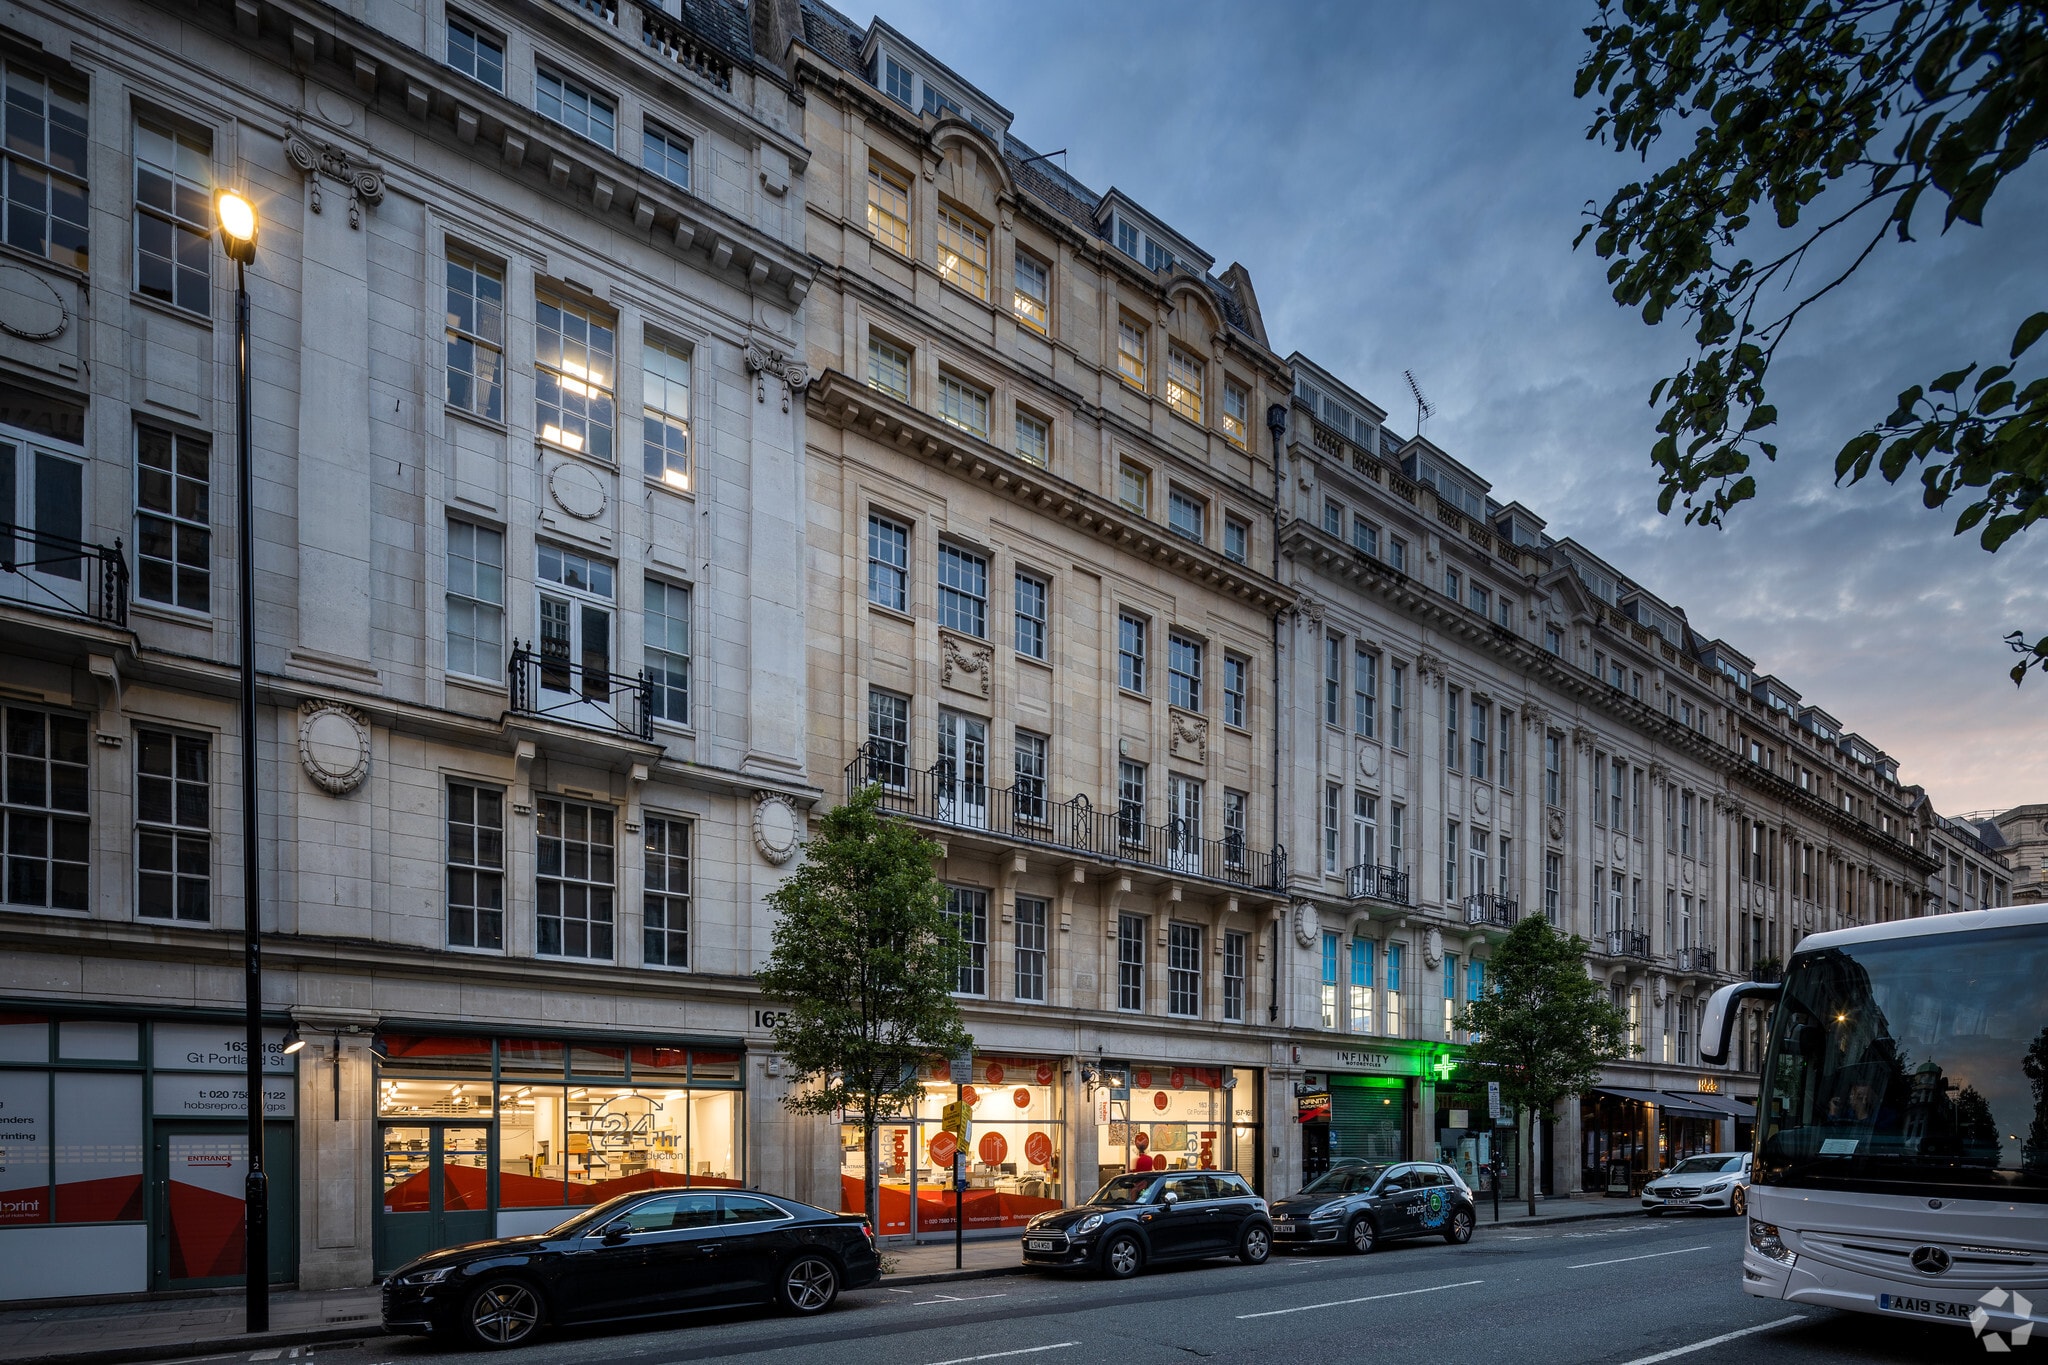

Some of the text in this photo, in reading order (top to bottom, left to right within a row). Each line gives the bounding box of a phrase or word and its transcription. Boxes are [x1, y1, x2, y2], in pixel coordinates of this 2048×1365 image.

[187, 1052, 284, 1066] Gt Portlad St
[1336, 1051, 1389, 1064] INFINITY
[209, 1090, 229, 1099] 020
[232, 1091, 249, 1099] 758
[184, 1101, 286, 1112] hobsrepro.c/gps
[0, 1132, 36, 1141] rinting
[894, 1129, 909, 1175] hobs
[1406, 1204, 1428, 1217] zipcar
[1894, 1297, 1971, 1318] AA19 SAR
